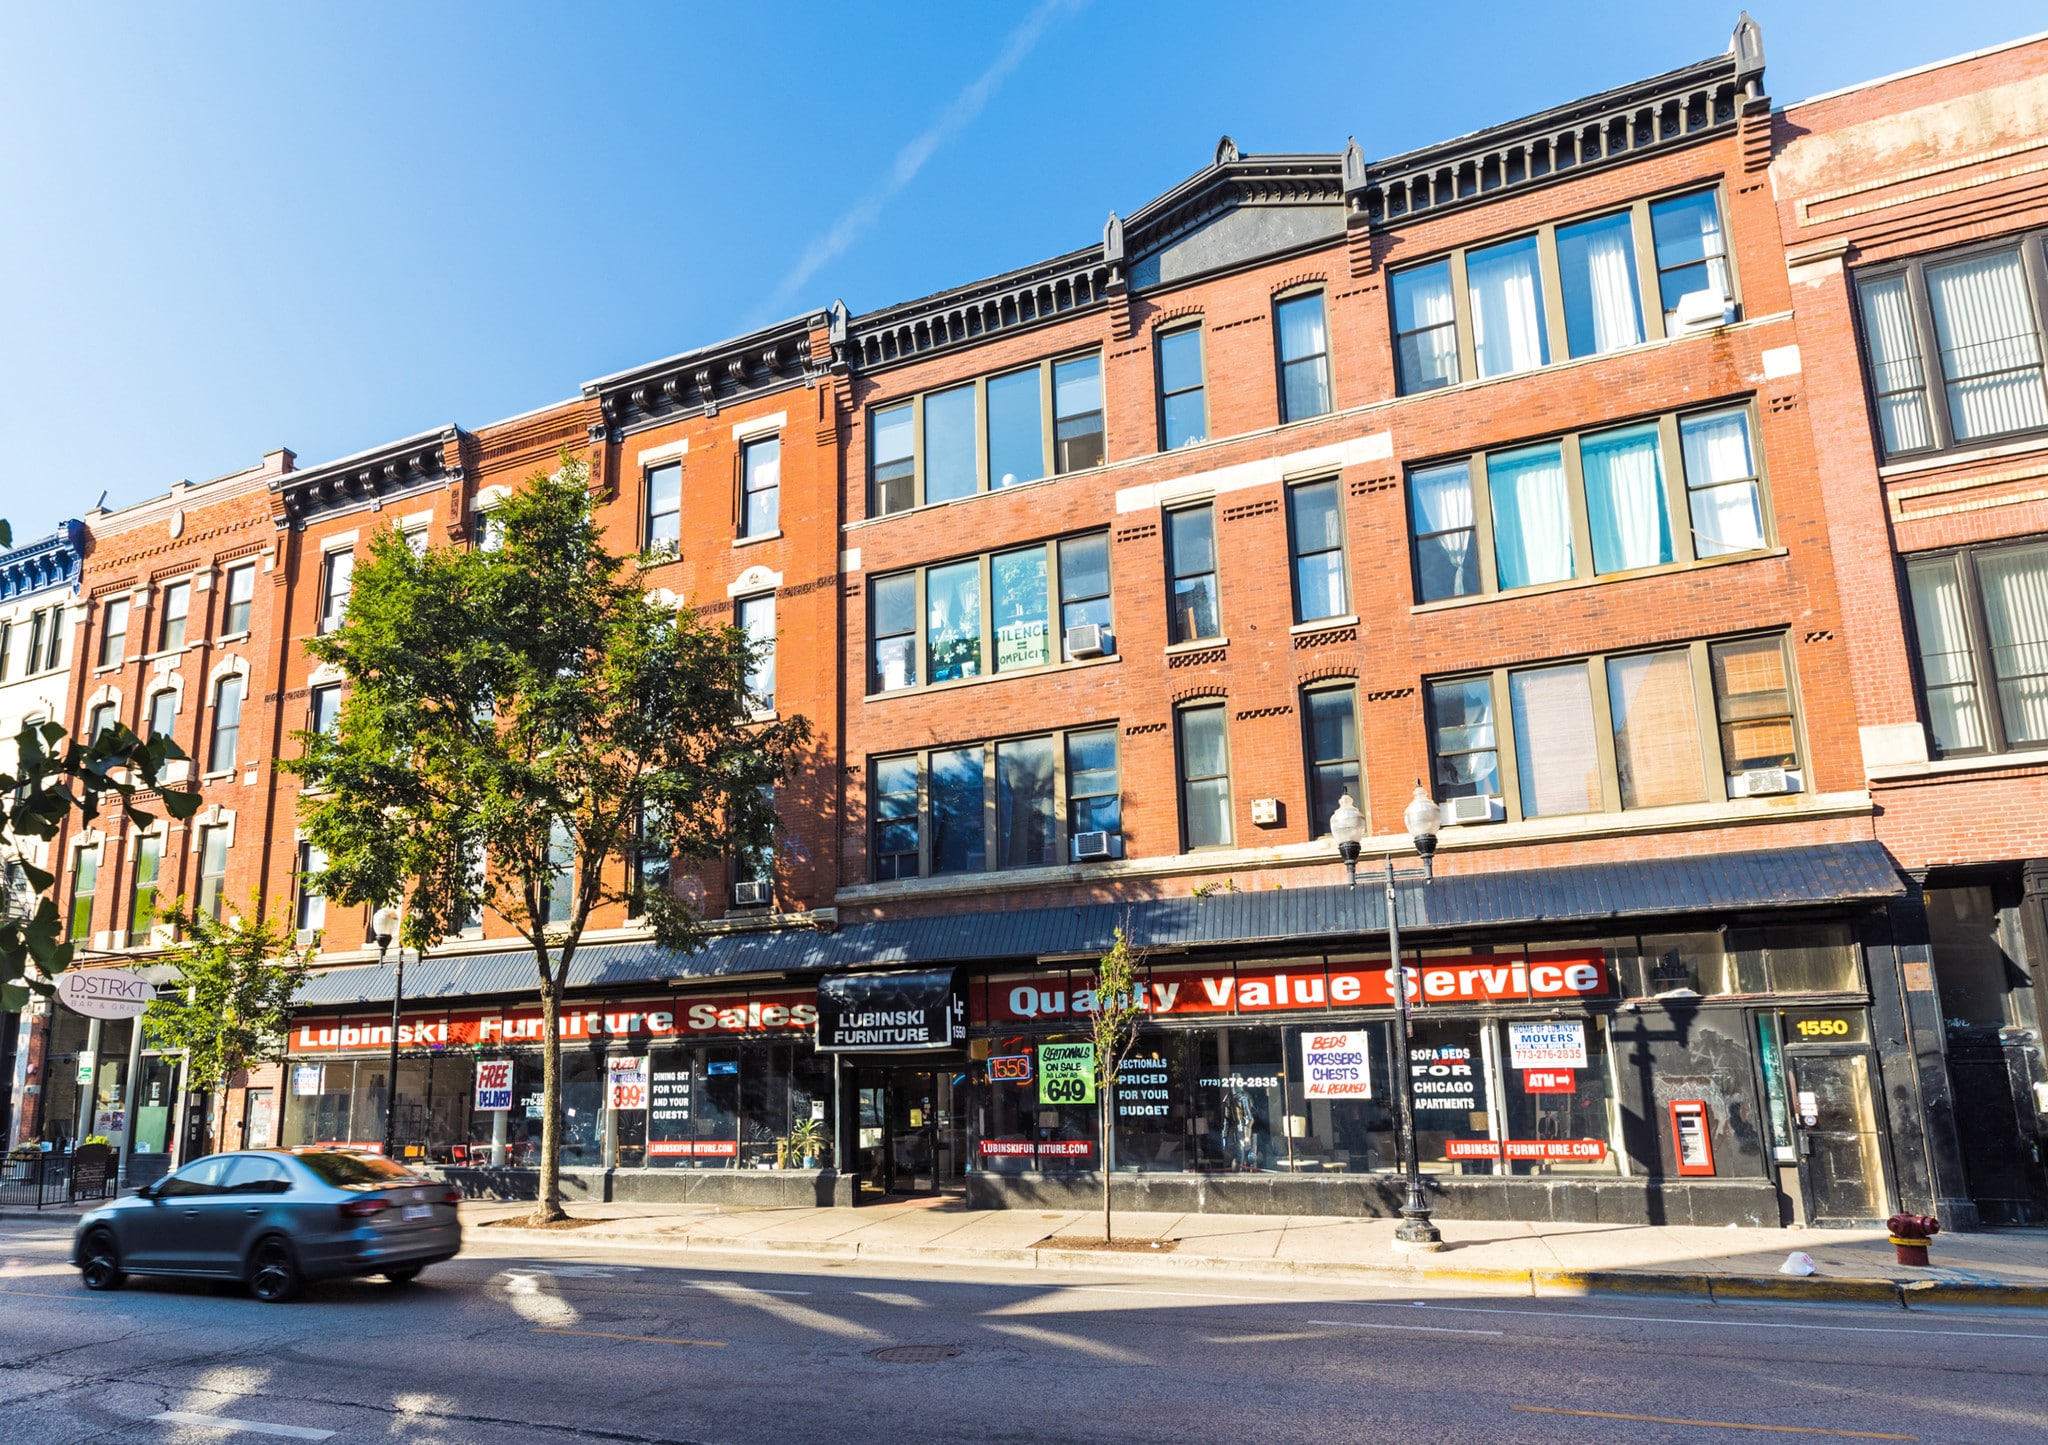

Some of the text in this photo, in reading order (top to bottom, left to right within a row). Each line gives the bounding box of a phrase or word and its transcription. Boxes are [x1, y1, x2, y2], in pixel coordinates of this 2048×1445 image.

[998, 624, 1049, 643] ILENCE
[1000, 649, 1049, 664] OMPLICIT
[71, 975, 147, 998] DSTRKT
[1009, 982, 1180, 1018] Quaty
[1202, 974, 1361, 1006] Value
[112, 1004, 143, 1012] GRILL
[299, 1019, 448, 1047] Lubinski
[688, 1002, 817, 1030] Sales
[839, 1010, 925, 1028] LUBINSKI
[952, 1025, 966, 1039] 1550
[1513, 1023, 1580, 1033] HOME OF LUBINSKI
[1796, 1019, 1849, 1035] 1550
[834, 1028, 929, 1043] FURNITURE
[1521, 1034, 1574, 1043] MOVERS
[1312, 1035, 1346, 1050] BEDS
[1042, 1046, 1091, 1062] SECTIONALS
[1307, 1052, 1363, 1066] DRESSERS
[1411, 1048, 1471, 1061] SOFA BEDS
[1516, 1049, 1582, 1059] 773-276-2835
[611, 1059, 640, 1071] QUEEN
[992, 1058, 1029, 1078] 1550
[1046, 1063, 1082, 1071] ON SALE
[1118, 1059, 1167, 1069] SECTIONALS
[478, 1065, 509, 1088] FREE
[653, 1072, 690, 1081] DINING SET
[1312, 1068, 1359, 1080] CHESTS
[1411, 1065, 1472, 1076] FOR
[1119, 1074, 1168, 1084] PRICED
[1200, 1077, 1278, 1088] (773) 276-2835
[1529, 1073, 1555, 1087] ATM
[653, 1085, 689, 1093] FOR YOU
[1309, 1082, 1367, 1095] ALL REDUCED
[1413, 1082, 1474, 1093] CHICAGO
[479, 1090, 512, 1107] DELIVERY
[613, 1085, 640, 1107] 399
[1119, 1090, 1169, 1100] FOR YOUR
[653, 1098, 668, 1106] AND
[669, 1098, 689, 1106] YOUR
[1415, 1098, 1475, 1110] APARTMENTS
[652, 1111, 689, 1119] GUESTS
[1119, 1105, 1169, 1116] BUDGET
